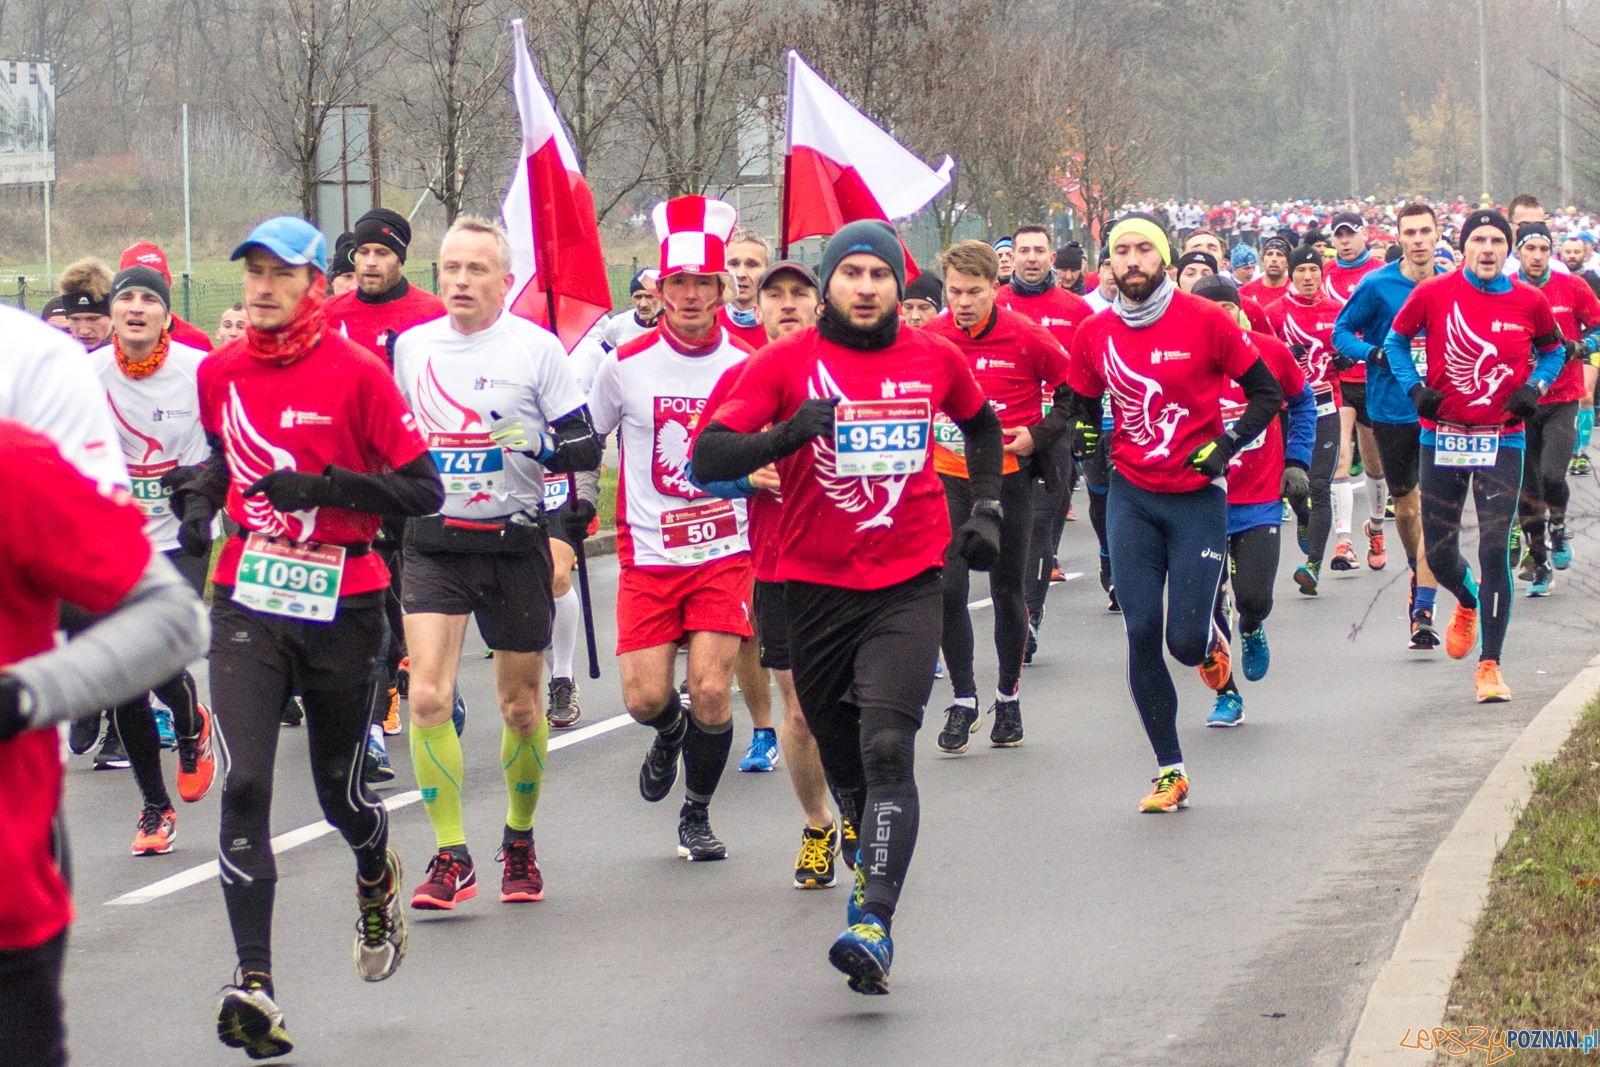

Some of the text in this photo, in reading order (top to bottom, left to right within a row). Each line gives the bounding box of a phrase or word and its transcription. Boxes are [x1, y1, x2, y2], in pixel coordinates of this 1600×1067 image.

[850, 425, 920, 451] 9545
[1445, 436, 1491, 451] 6815
[441, 452, 487, 472] 747
[687, 522, 716, 543] 50
[253, 559, 329, 594] 1096
[869, 801, 902, 876] kalenji
